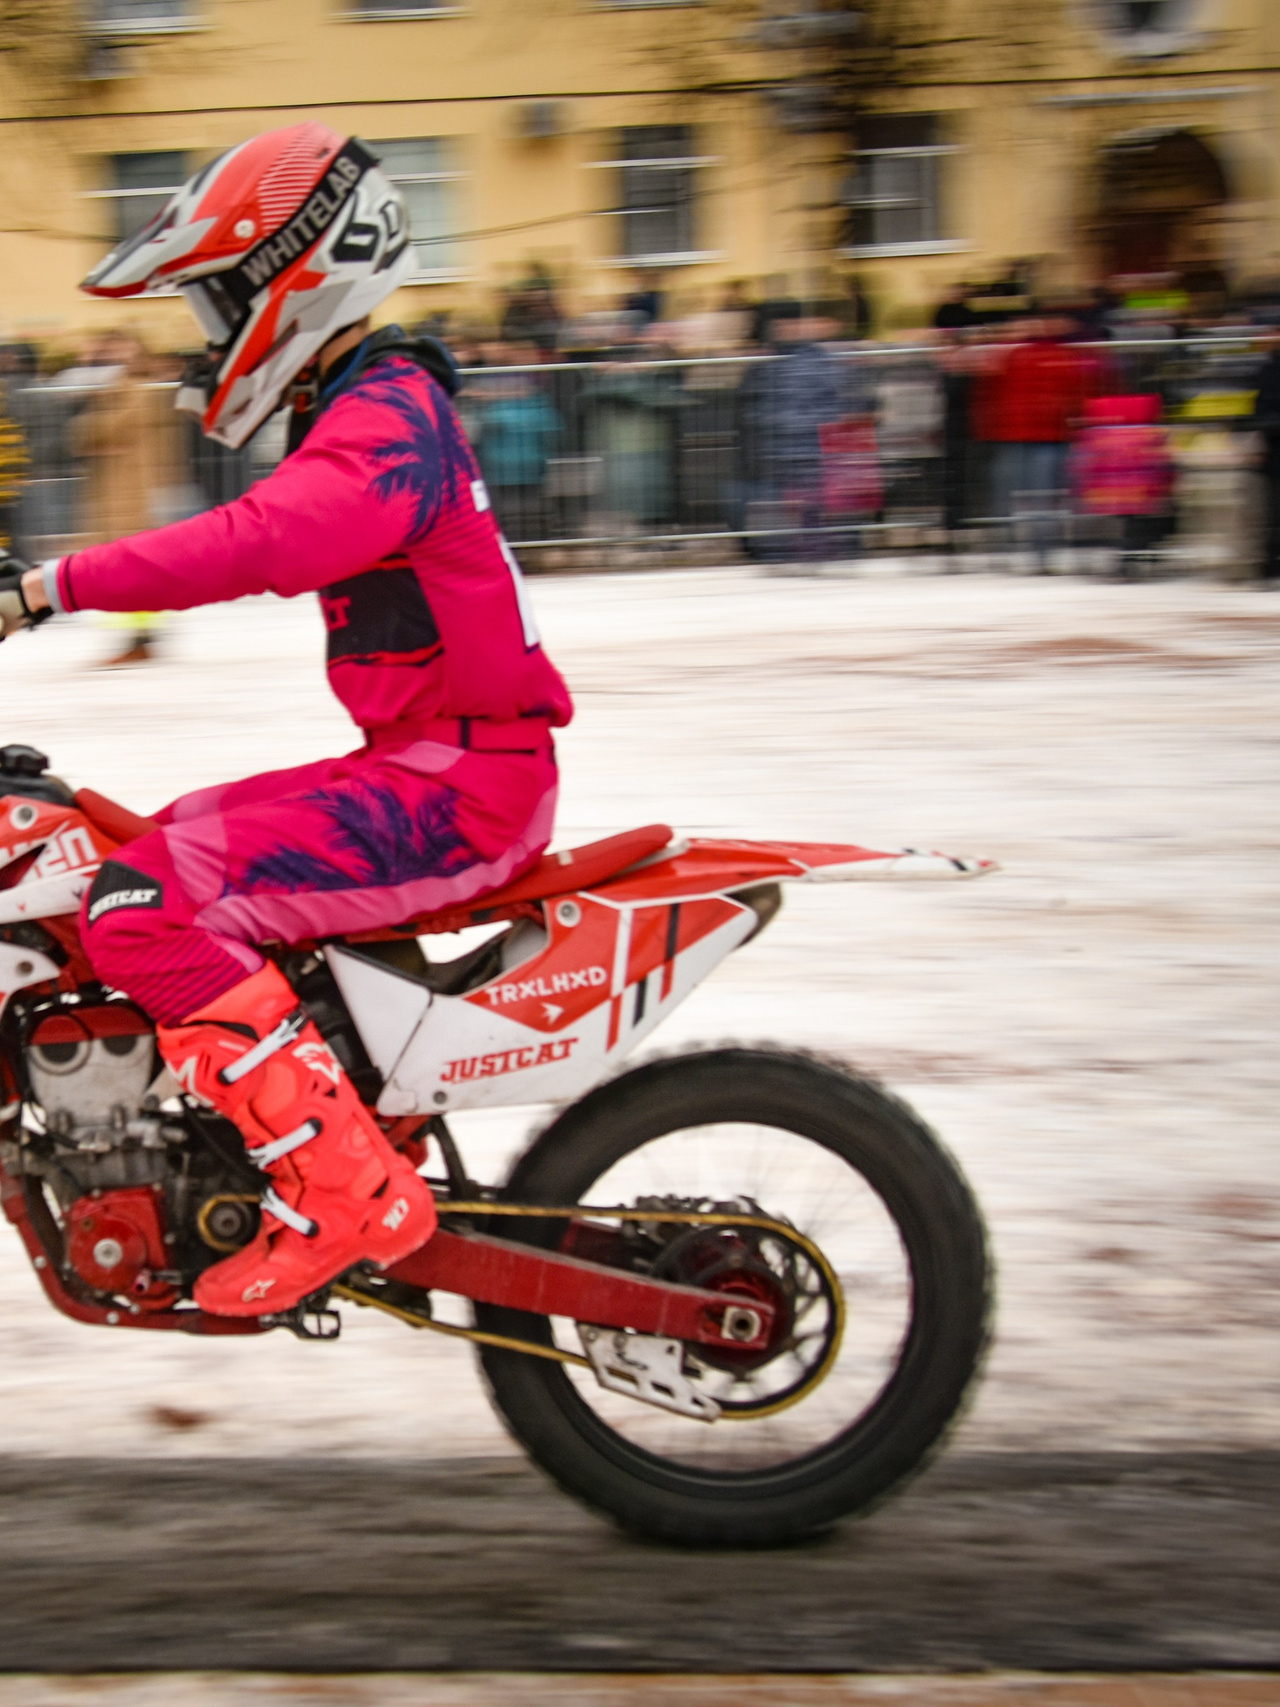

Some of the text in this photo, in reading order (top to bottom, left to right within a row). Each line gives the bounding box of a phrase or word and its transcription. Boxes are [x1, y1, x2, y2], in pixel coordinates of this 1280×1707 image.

[240, 156, 360, 286] WHITELAB
[484, 966, 608, 1006] TRXLHXD
[440, 1037, 579, 1084] JUSTCAT
